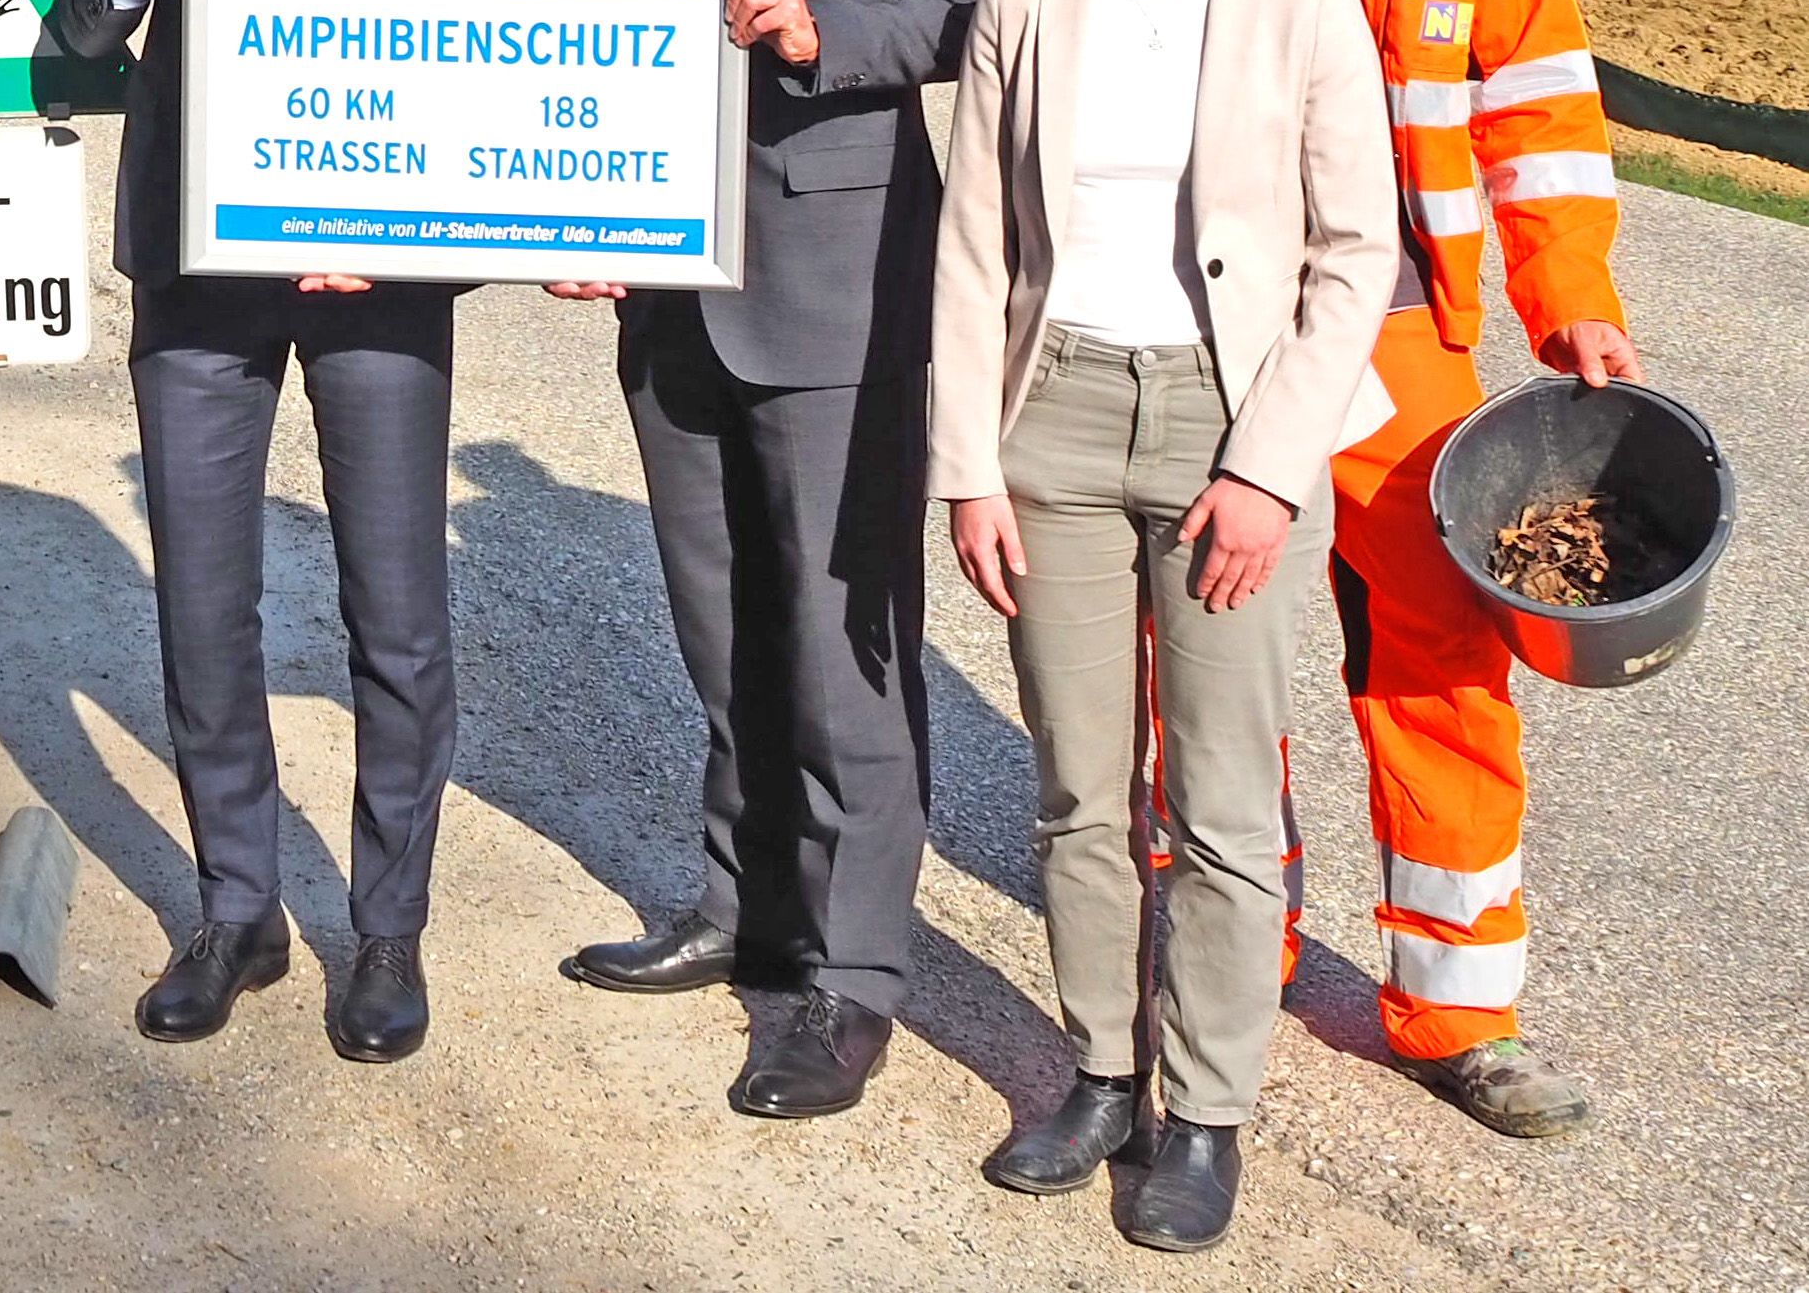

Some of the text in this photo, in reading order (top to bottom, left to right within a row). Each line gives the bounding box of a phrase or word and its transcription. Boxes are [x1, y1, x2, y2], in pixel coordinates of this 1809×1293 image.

[237, 14, 677, 68] AMPHIBIENSCHUTZ
[286, 87, 394, 121] 60 KM
[540, 96, 599, 129] 188
[253, 137, 426, 175] STRASSEN
[468, 146, 669, 183] STANDORTE
[281, 216, 687, 247] eine Initiative von LH-Stellvertreter Udo Landbauer
